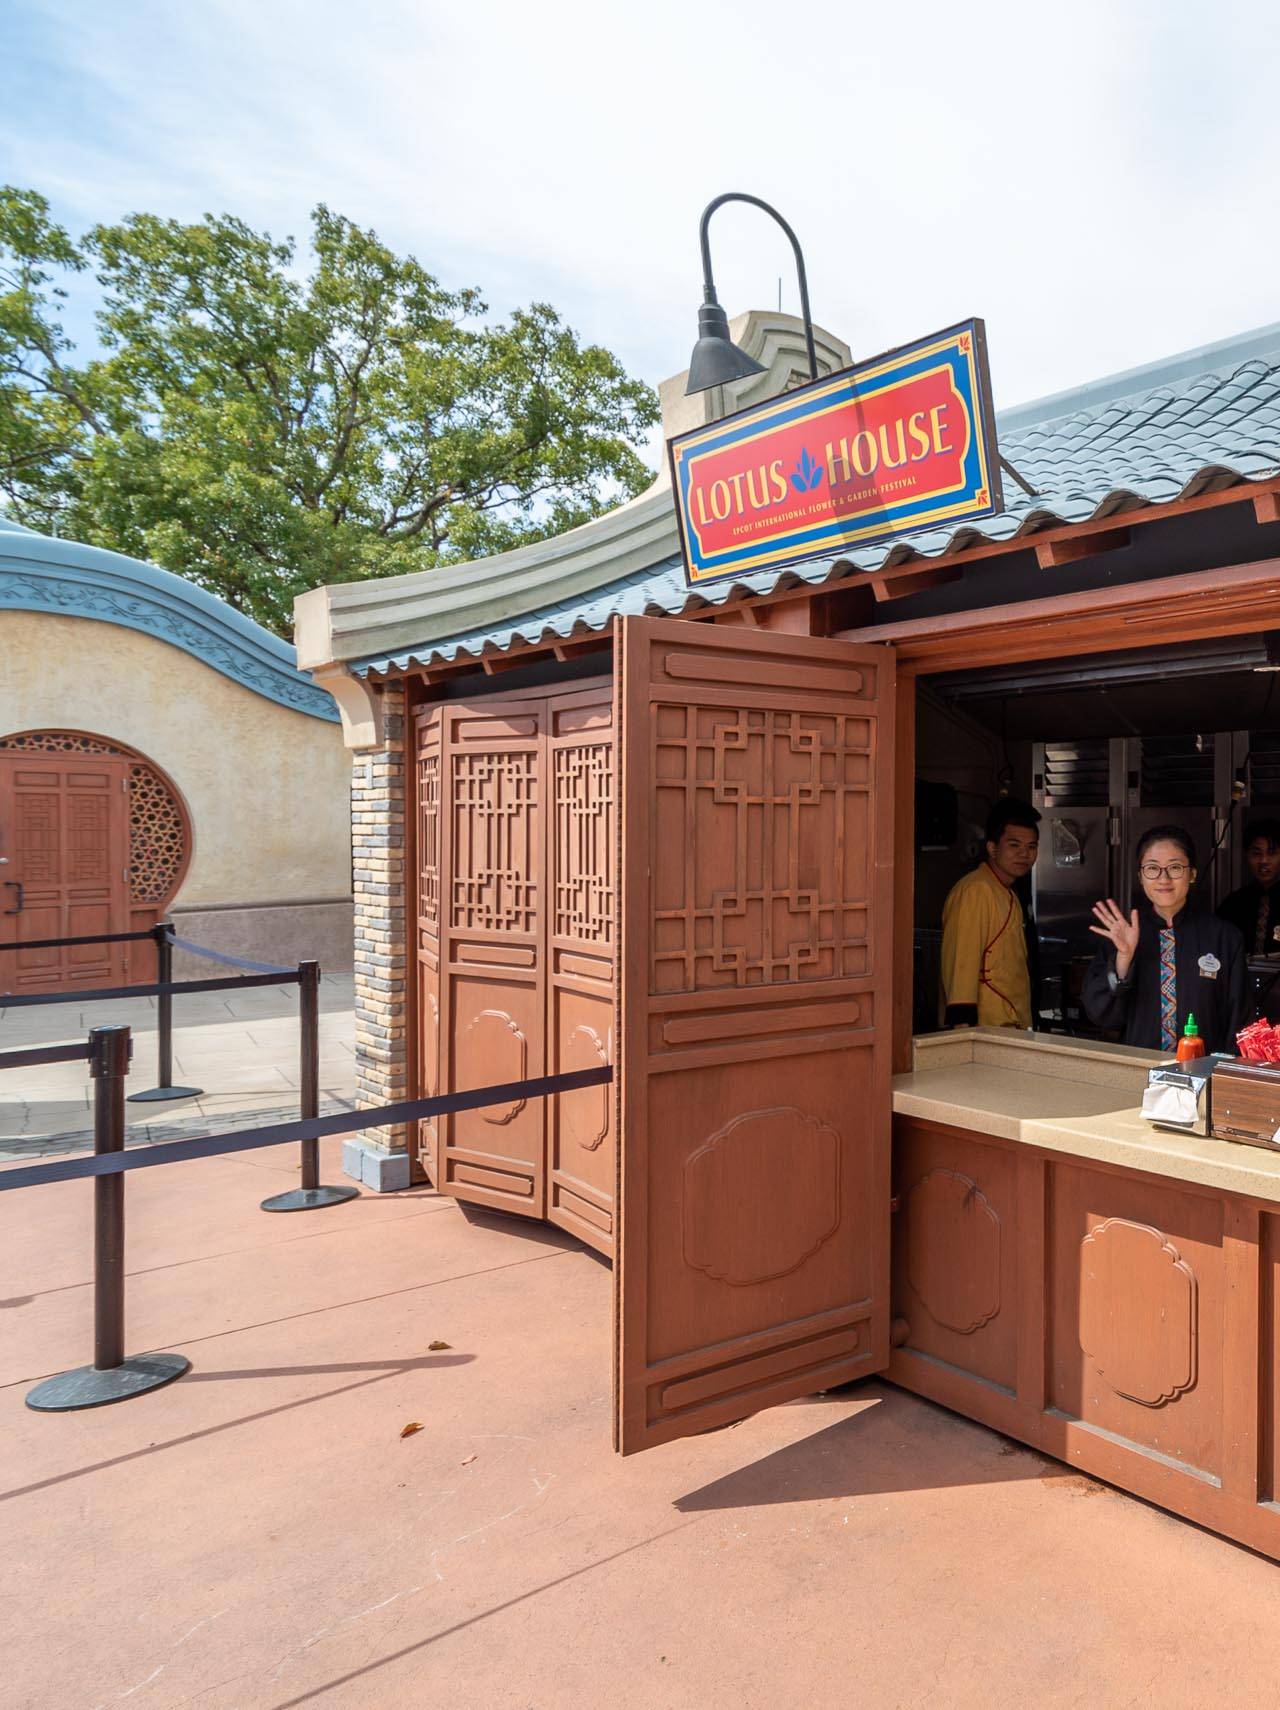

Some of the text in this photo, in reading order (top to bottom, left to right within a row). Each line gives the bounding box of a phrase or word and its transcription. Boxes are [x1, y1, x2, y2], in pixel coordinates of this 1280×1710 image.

[696, 403, 953, 525] LOTUS HOUSE
[733, 523, 753, 536] EPCOT
[754, 506, 807, 529] INTERNATIONAL
[808, 499, 837, 514] FLOWER
[847, 488, 878, 503] GARDEN
[880, 475, 917, 494] FESTIVAL
